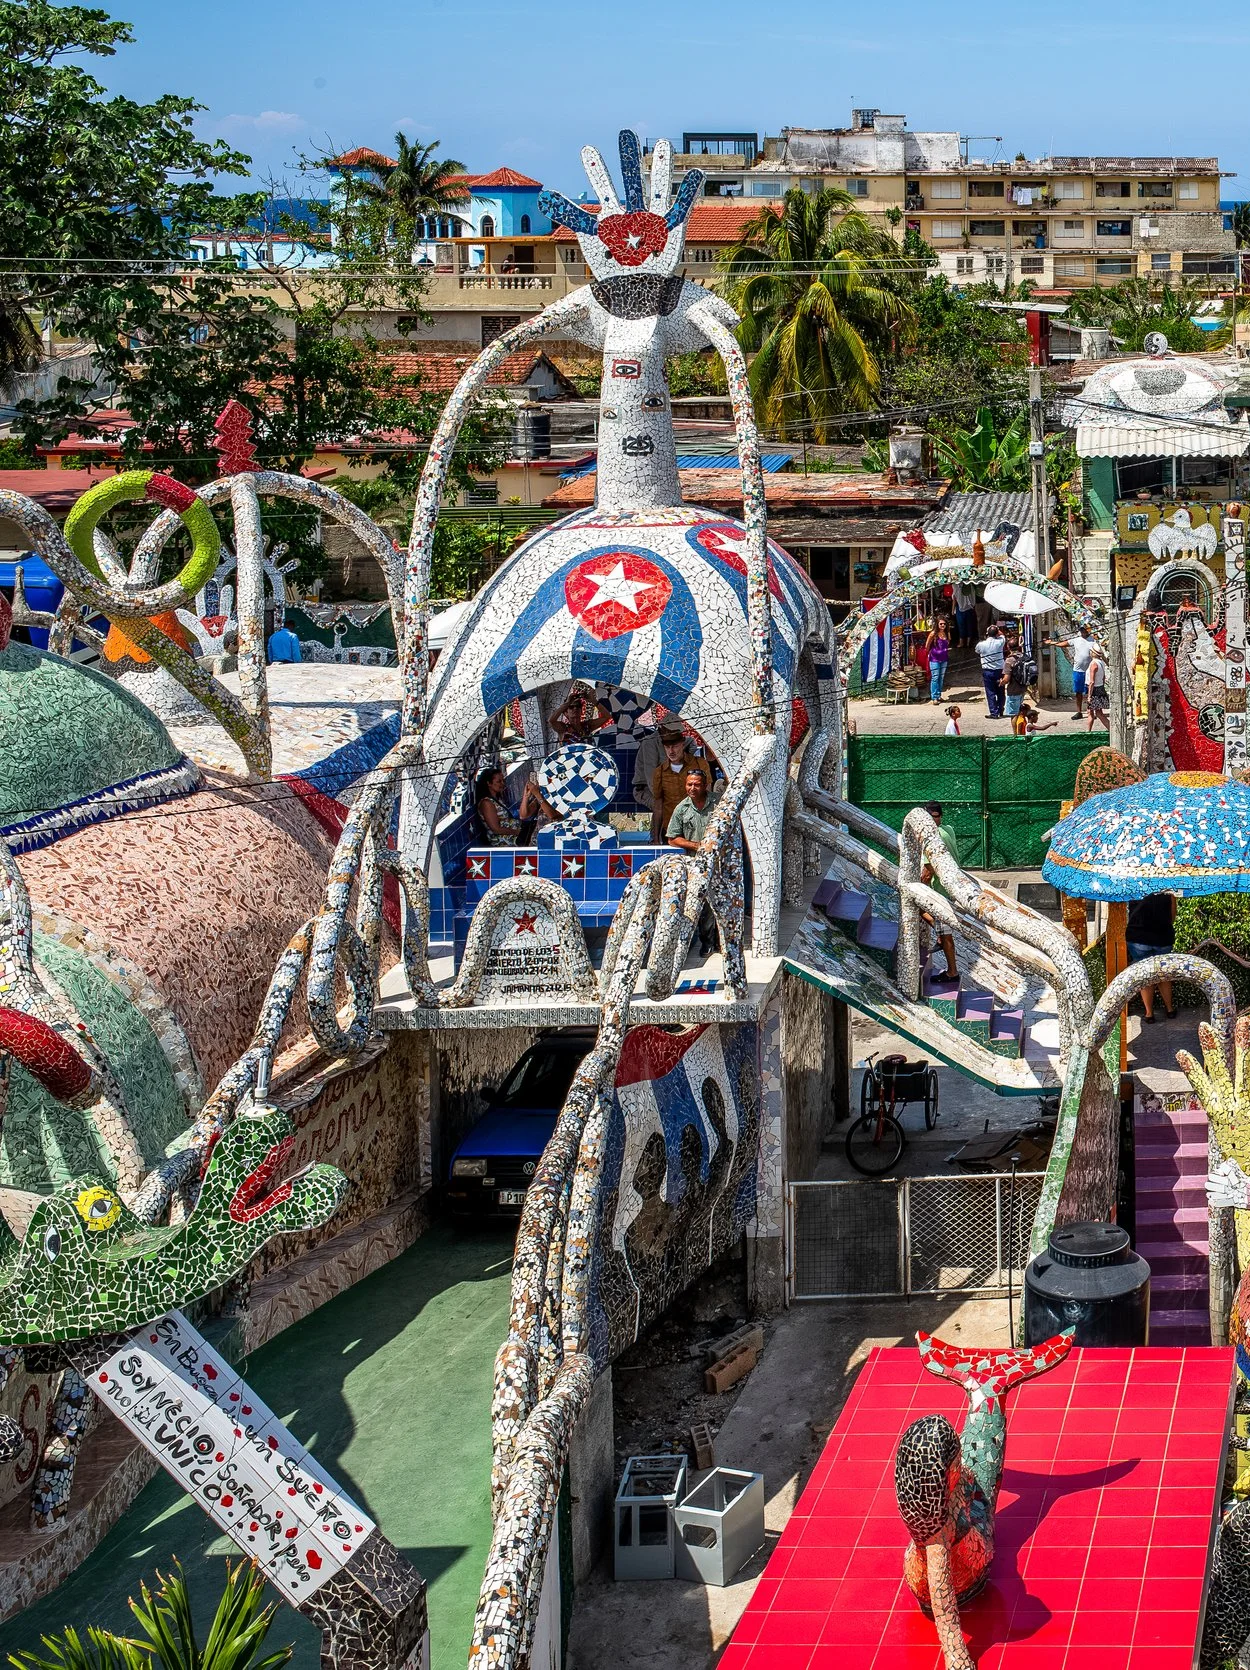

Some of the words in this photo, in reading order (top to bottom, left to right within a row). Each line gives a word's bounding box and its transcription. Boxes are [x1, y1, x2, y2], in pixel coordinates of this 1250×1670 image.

[490, 948, 521, 956] OLIMPO
[523, 948, 534, 956] DE
[535, 947, 552, 956] LOS
[552, 945, 560, 954] 5
[486, 958, 521, 968] ABIERTO
[501, 984, 544, 994] JAIMANITAS
